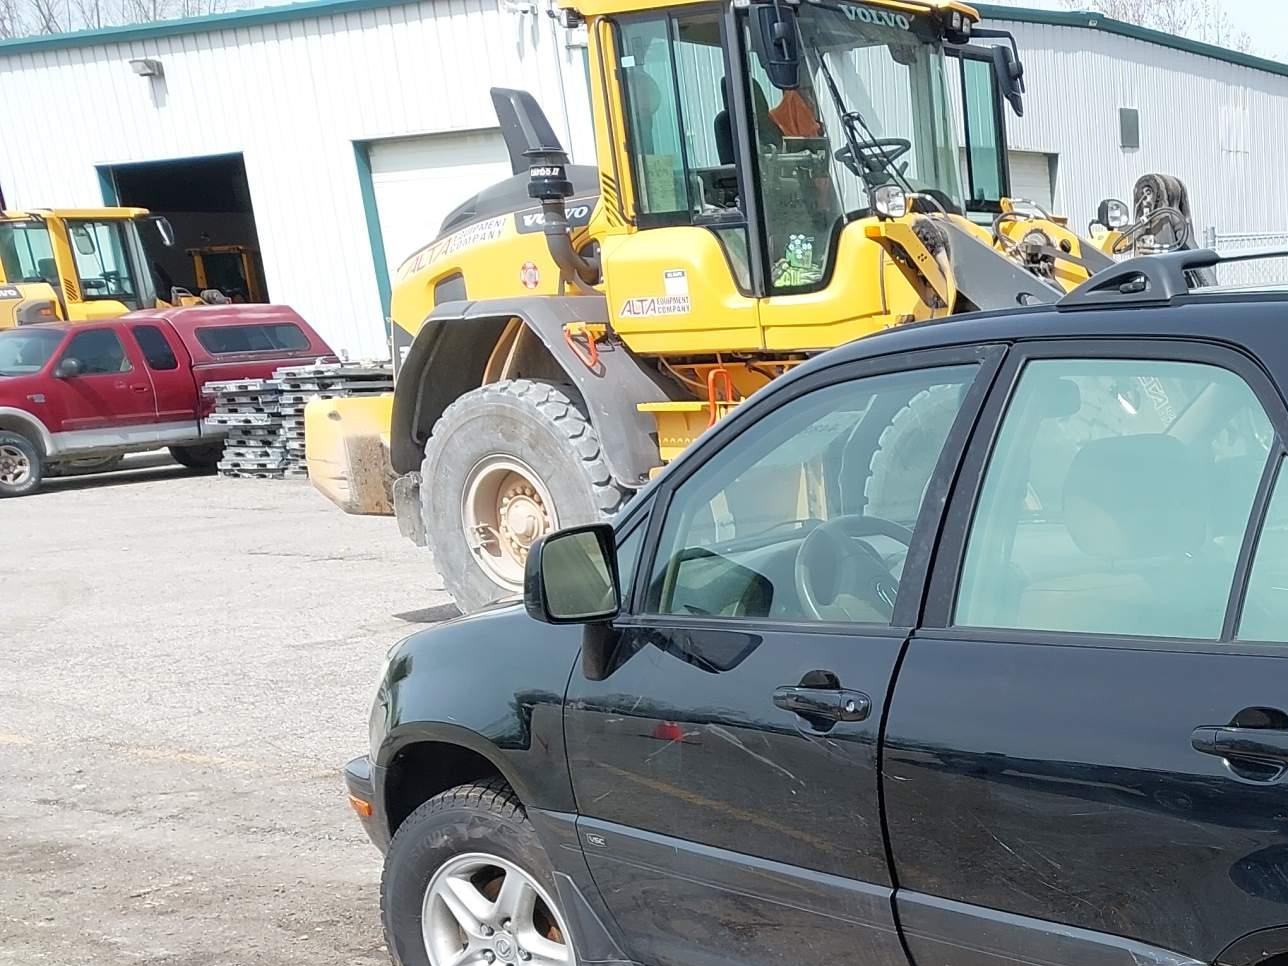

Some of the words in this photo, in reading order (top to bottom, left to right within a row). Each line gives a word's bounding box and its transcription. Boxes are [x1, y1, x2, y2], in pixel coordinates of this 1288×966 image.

[837, 4, 910, 30] VOLVO
[453, 217, 507, 240] EQUIPMENT
[450, 230, 503, 253] COMPANY
[402, 237, 452, 280] ALTA
[620, 298, 657, 316] ALTA
[656, 296, 689, 306] EQUIPMENT
[657, 304, 690, 314] COMPANY
